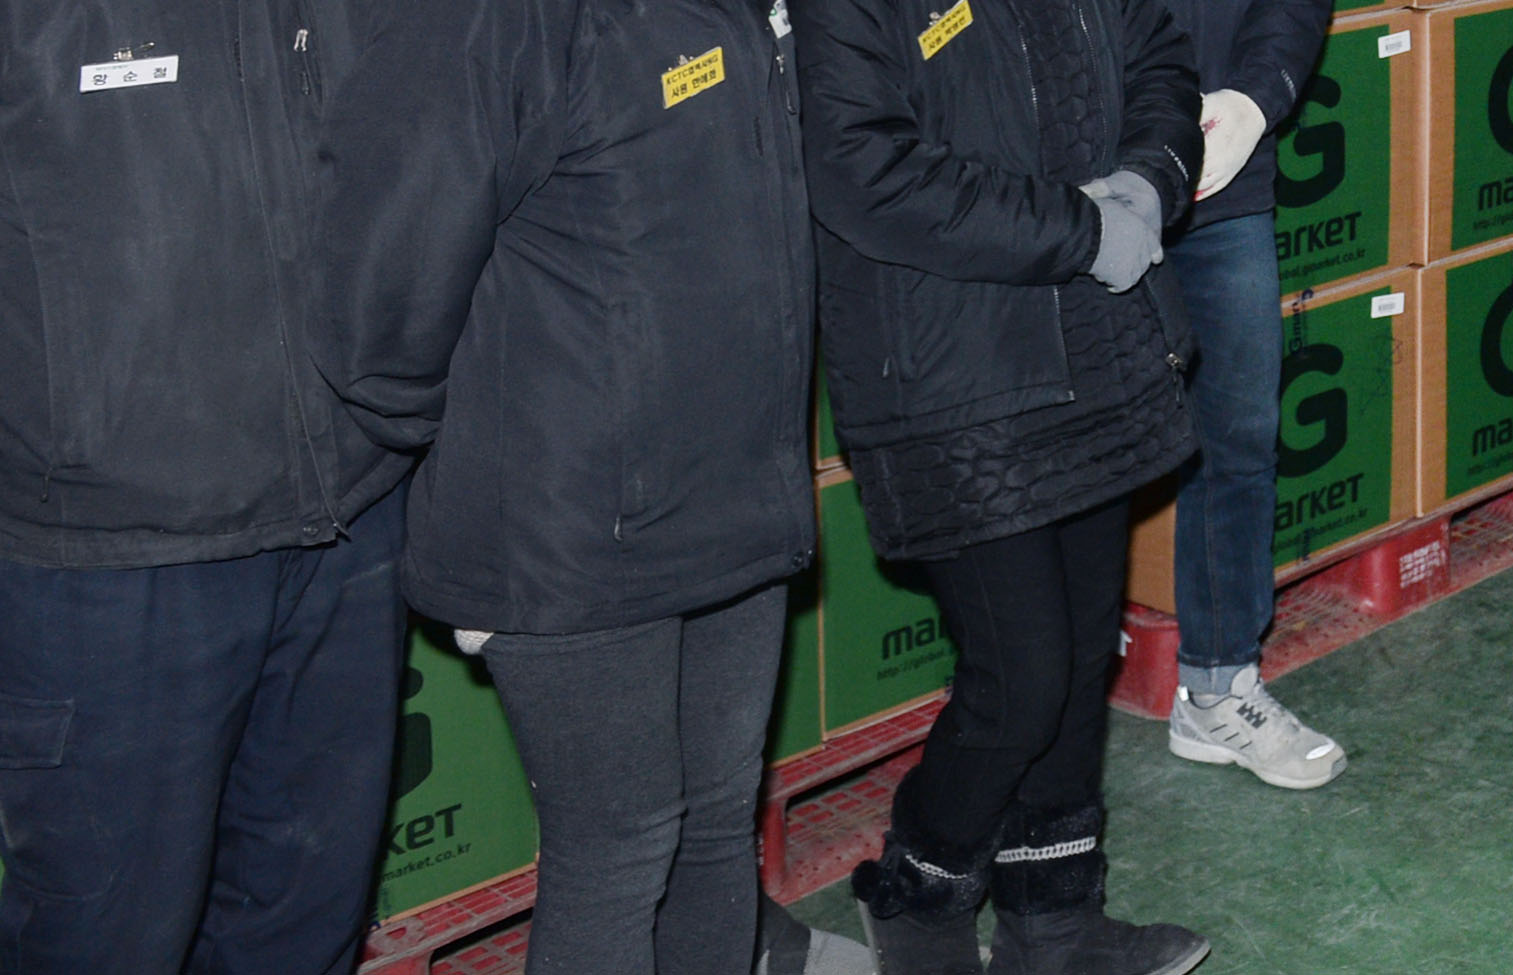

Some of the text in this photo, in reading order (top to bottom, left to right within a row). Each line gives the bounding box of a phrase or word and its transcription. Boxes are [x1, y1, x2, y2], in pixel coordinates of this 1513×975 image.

[1275, 211, 1361, 260] arket
[1273, 472, 1364, 534] arket
[385, 803, 462, 855] ket
